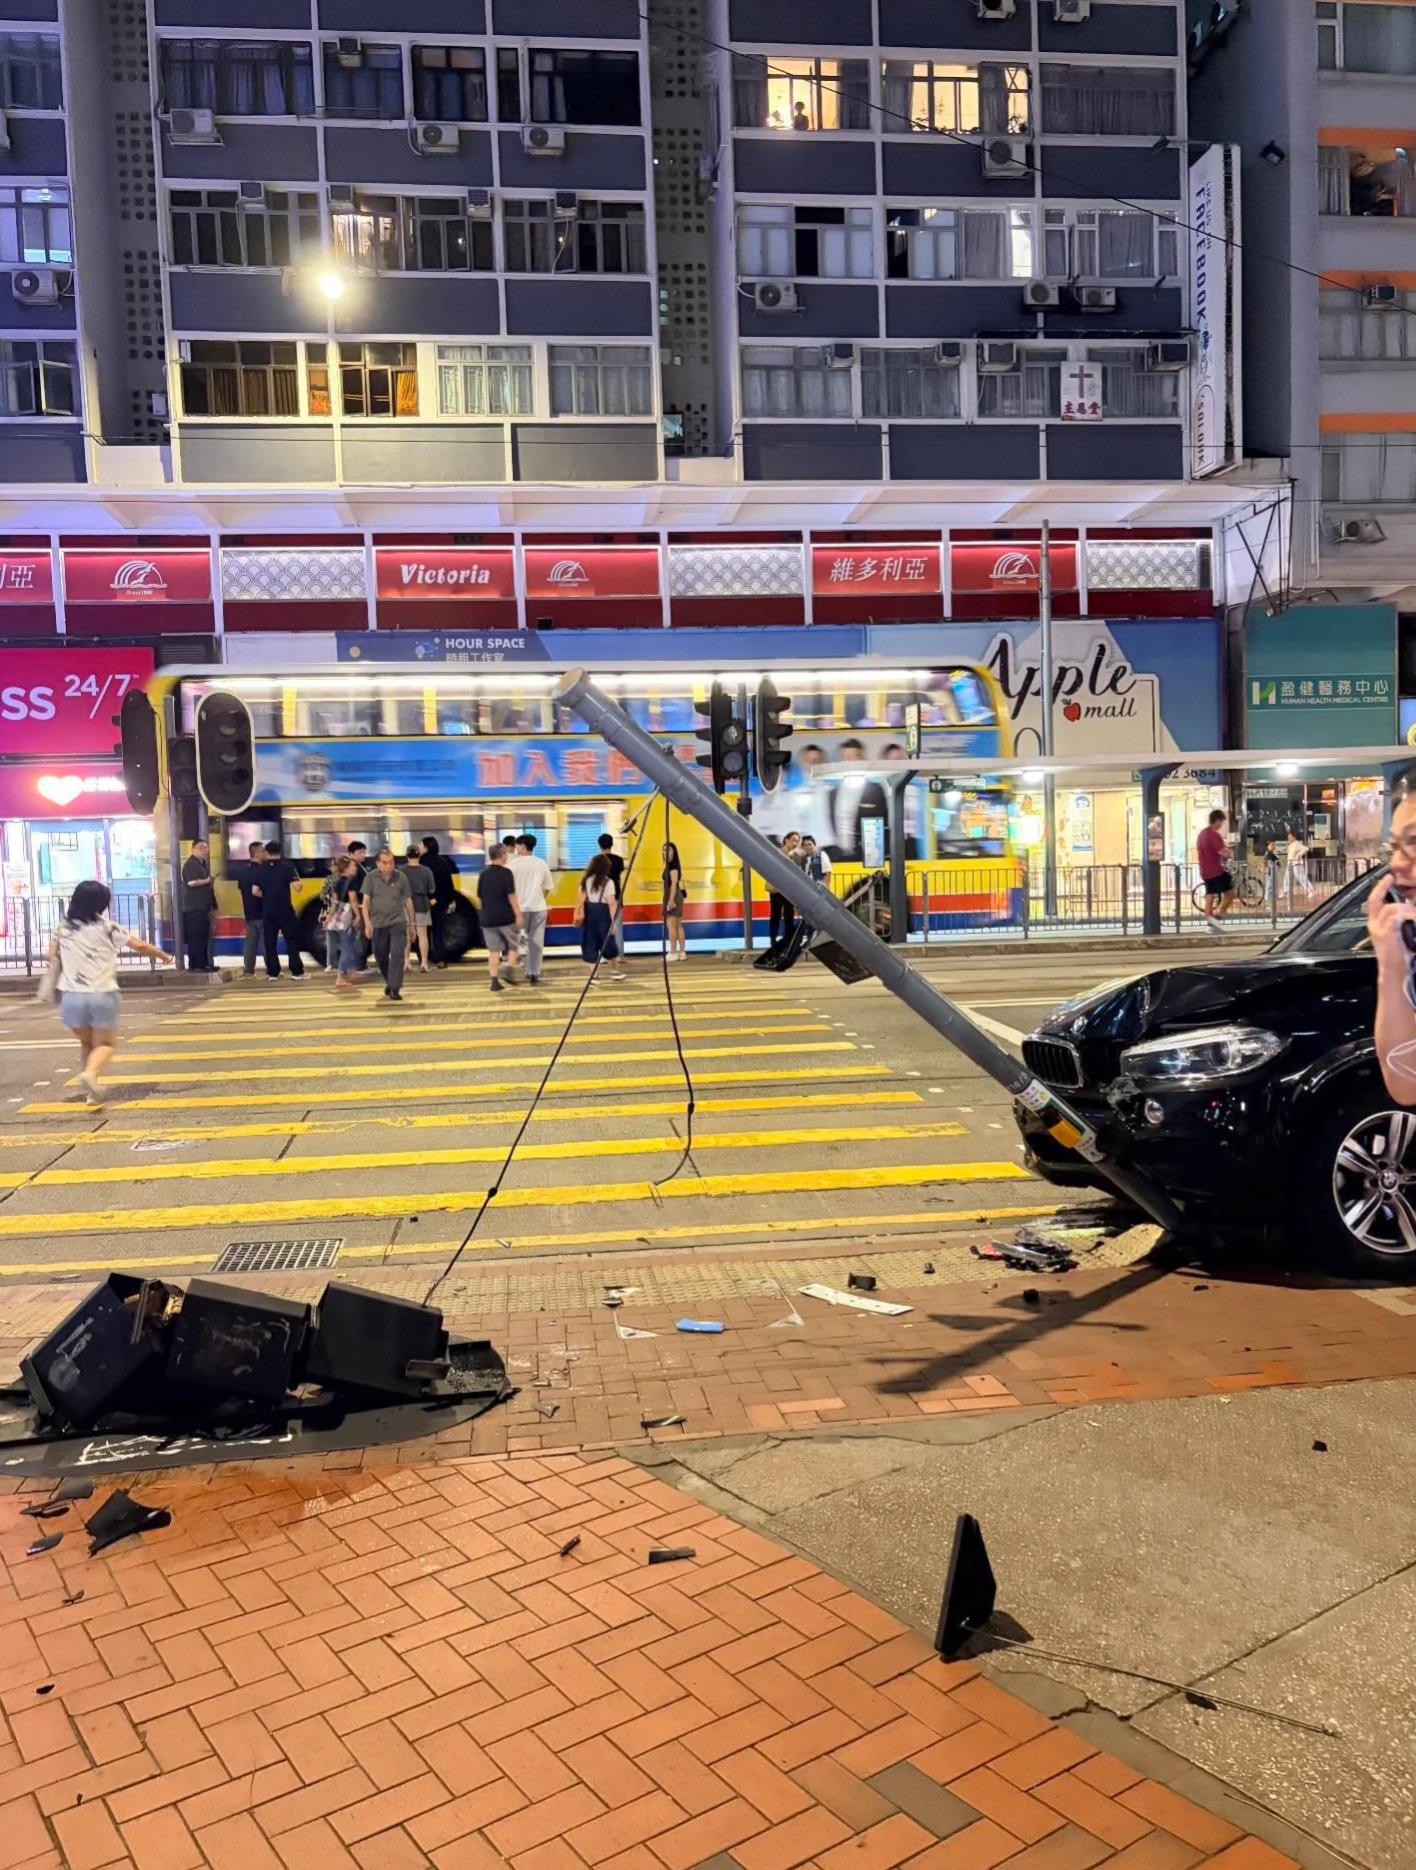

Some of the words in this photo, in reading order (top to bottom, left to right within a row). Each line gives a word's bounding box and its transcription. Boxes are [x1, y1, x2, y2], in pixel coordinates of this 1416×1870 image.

[1196, 187, 1206, 325] FACEBOOK
[400, 564, 490, 585] Victoria
[829, 557, 928, 582] 維多利亞
[445, 639, 483, 648] HOUR
[487, 638, 525, 648] SPACE
[988, 638, 1137, 720] Apple
[1280, 680, 1390, 697] 盈健醫務中心
[64, 674, 131, 719] 24/7
[1083, 697, 1138, 718] mall
